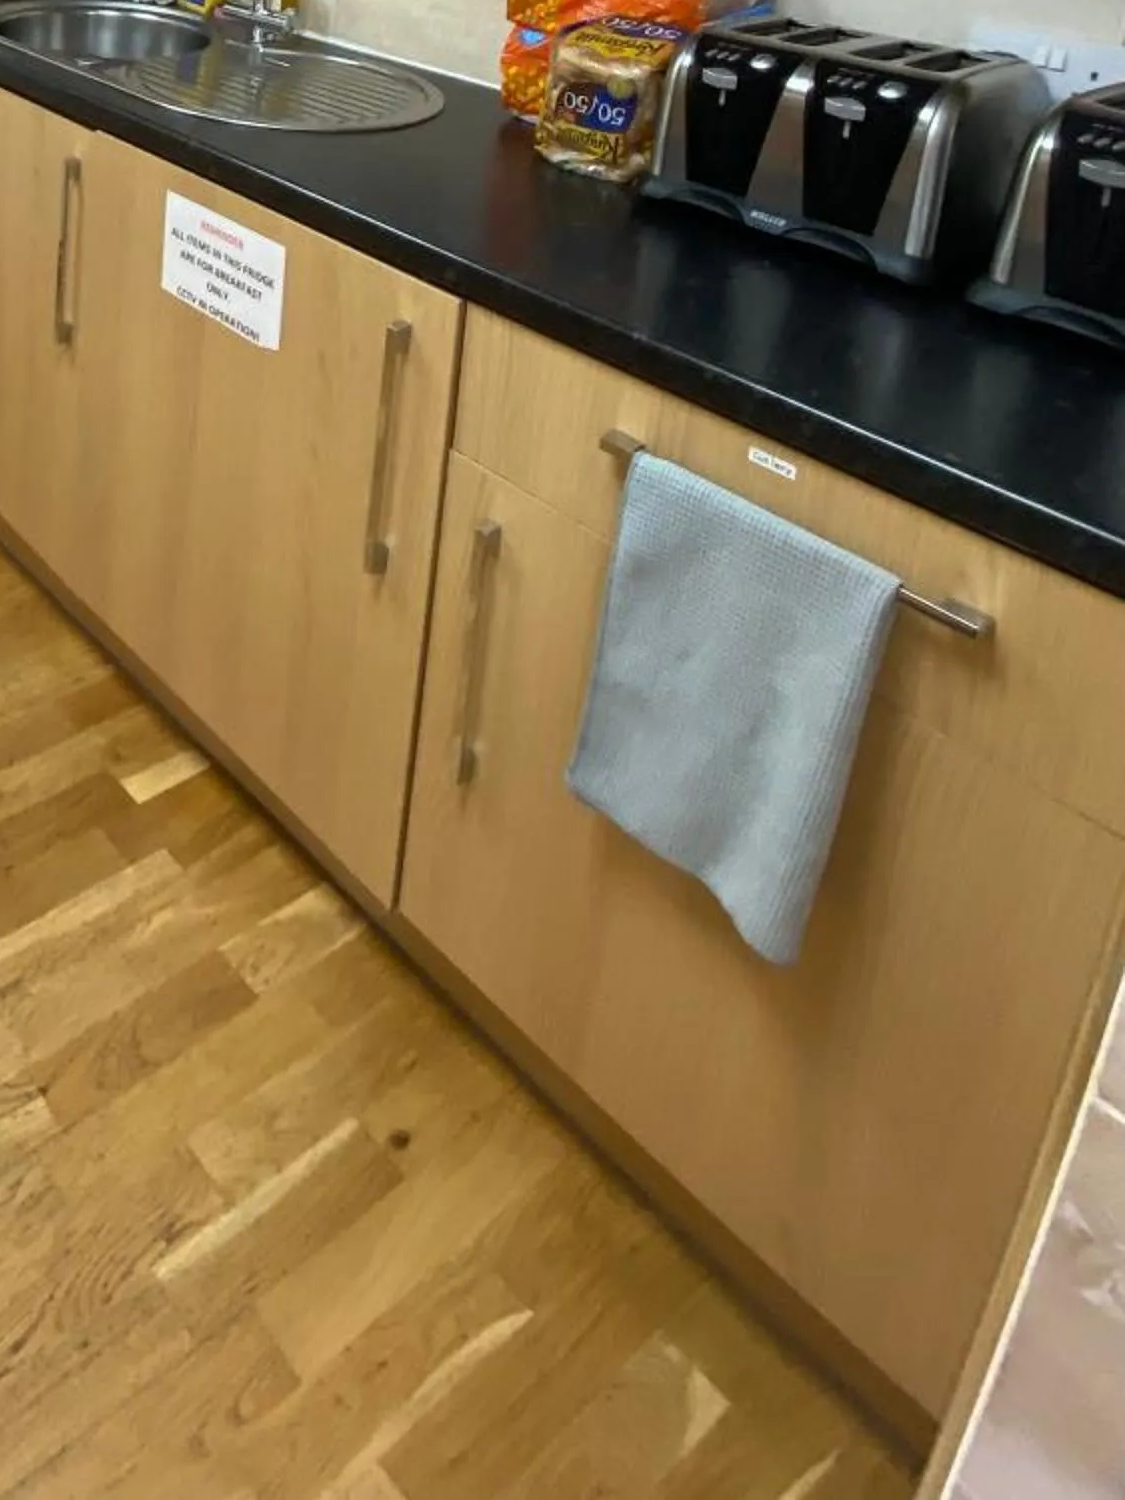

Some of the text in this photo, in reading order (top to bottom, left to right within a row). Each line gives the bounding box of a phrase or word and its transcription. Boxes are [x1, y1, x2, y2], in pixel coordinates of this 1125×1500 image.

[563, 90, 627, 126] 50/50
[171, 227, 184, 241] ALL
[186, 232, 211, 254] ITEMS
[223, 252, 241, 272] THIS
[242, 263, 275, 289] FRIDGE
[180, 249, 262, 301] ARE FOR BREAKFAST
[177, 285, 197, 303] CCTV
[206, 280, 229, 301] ONLY
